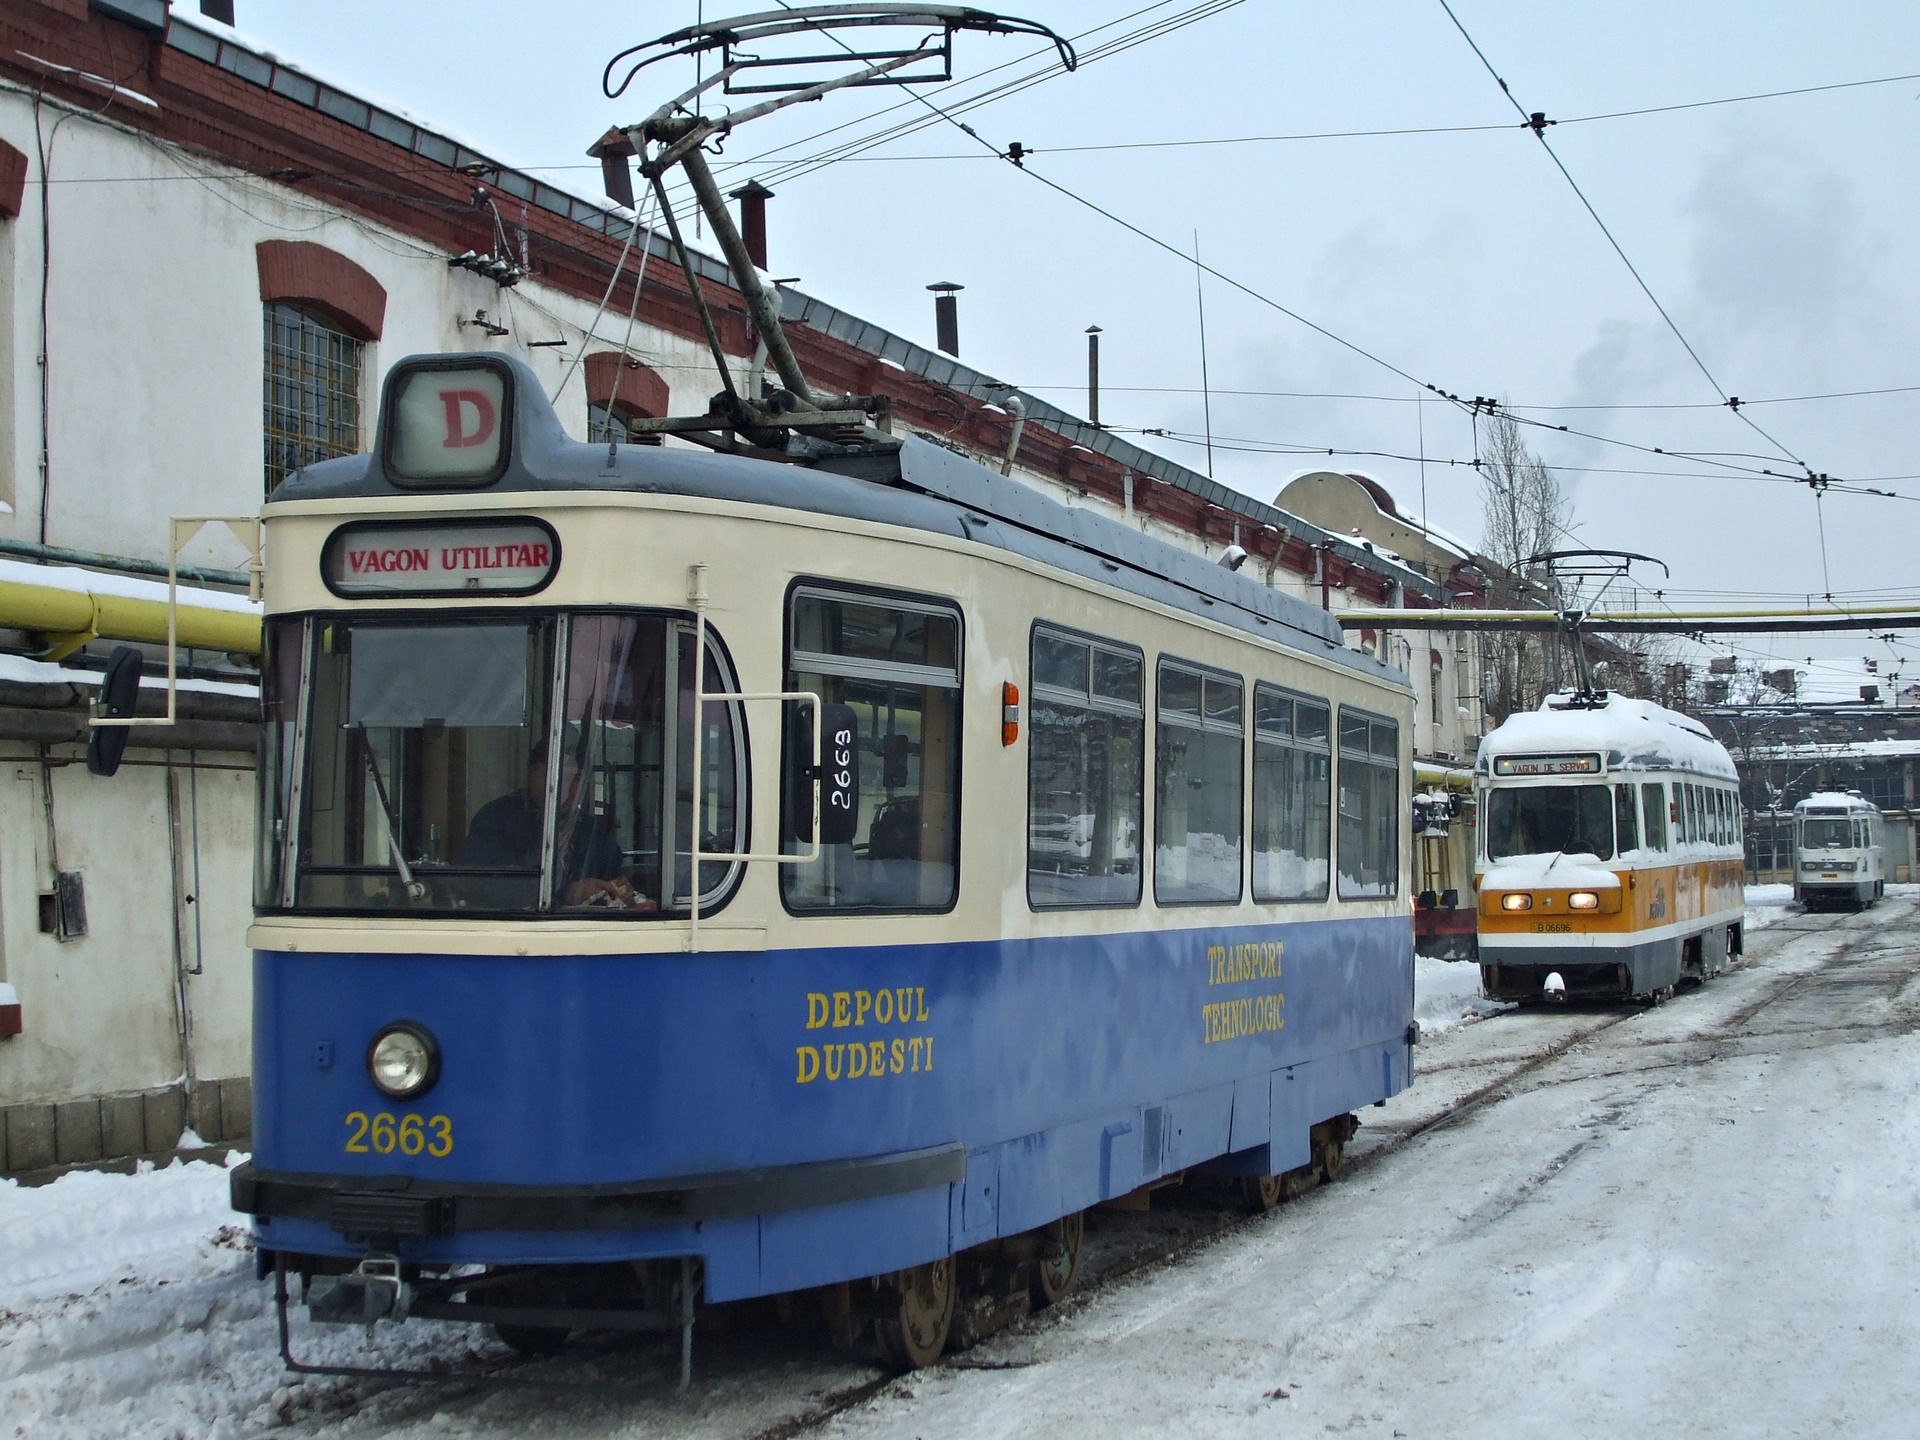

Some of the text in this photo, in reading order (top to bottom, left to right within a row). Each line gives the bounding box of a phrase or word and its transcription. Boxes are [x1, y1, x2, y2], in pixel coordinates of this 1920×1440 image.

[439, 390, 494, 448] D
[349, 543, 550, 573] VAGON UTILITAR
[831, 729, 851, 810] 2663
[1512, 764, 1538, 774] VAGON
[1544, 763, 1555, 773] DE
[1207, 941, 1284, 986] TRANSPORT
[806, 987, 930, 1029] DEPOUL
[1202, 993, 1285, 1044] TEHNOLOGIC
[796, 1036, 934, 1084] DUDESTI
[345, 1111, 453, 1158] 2663
